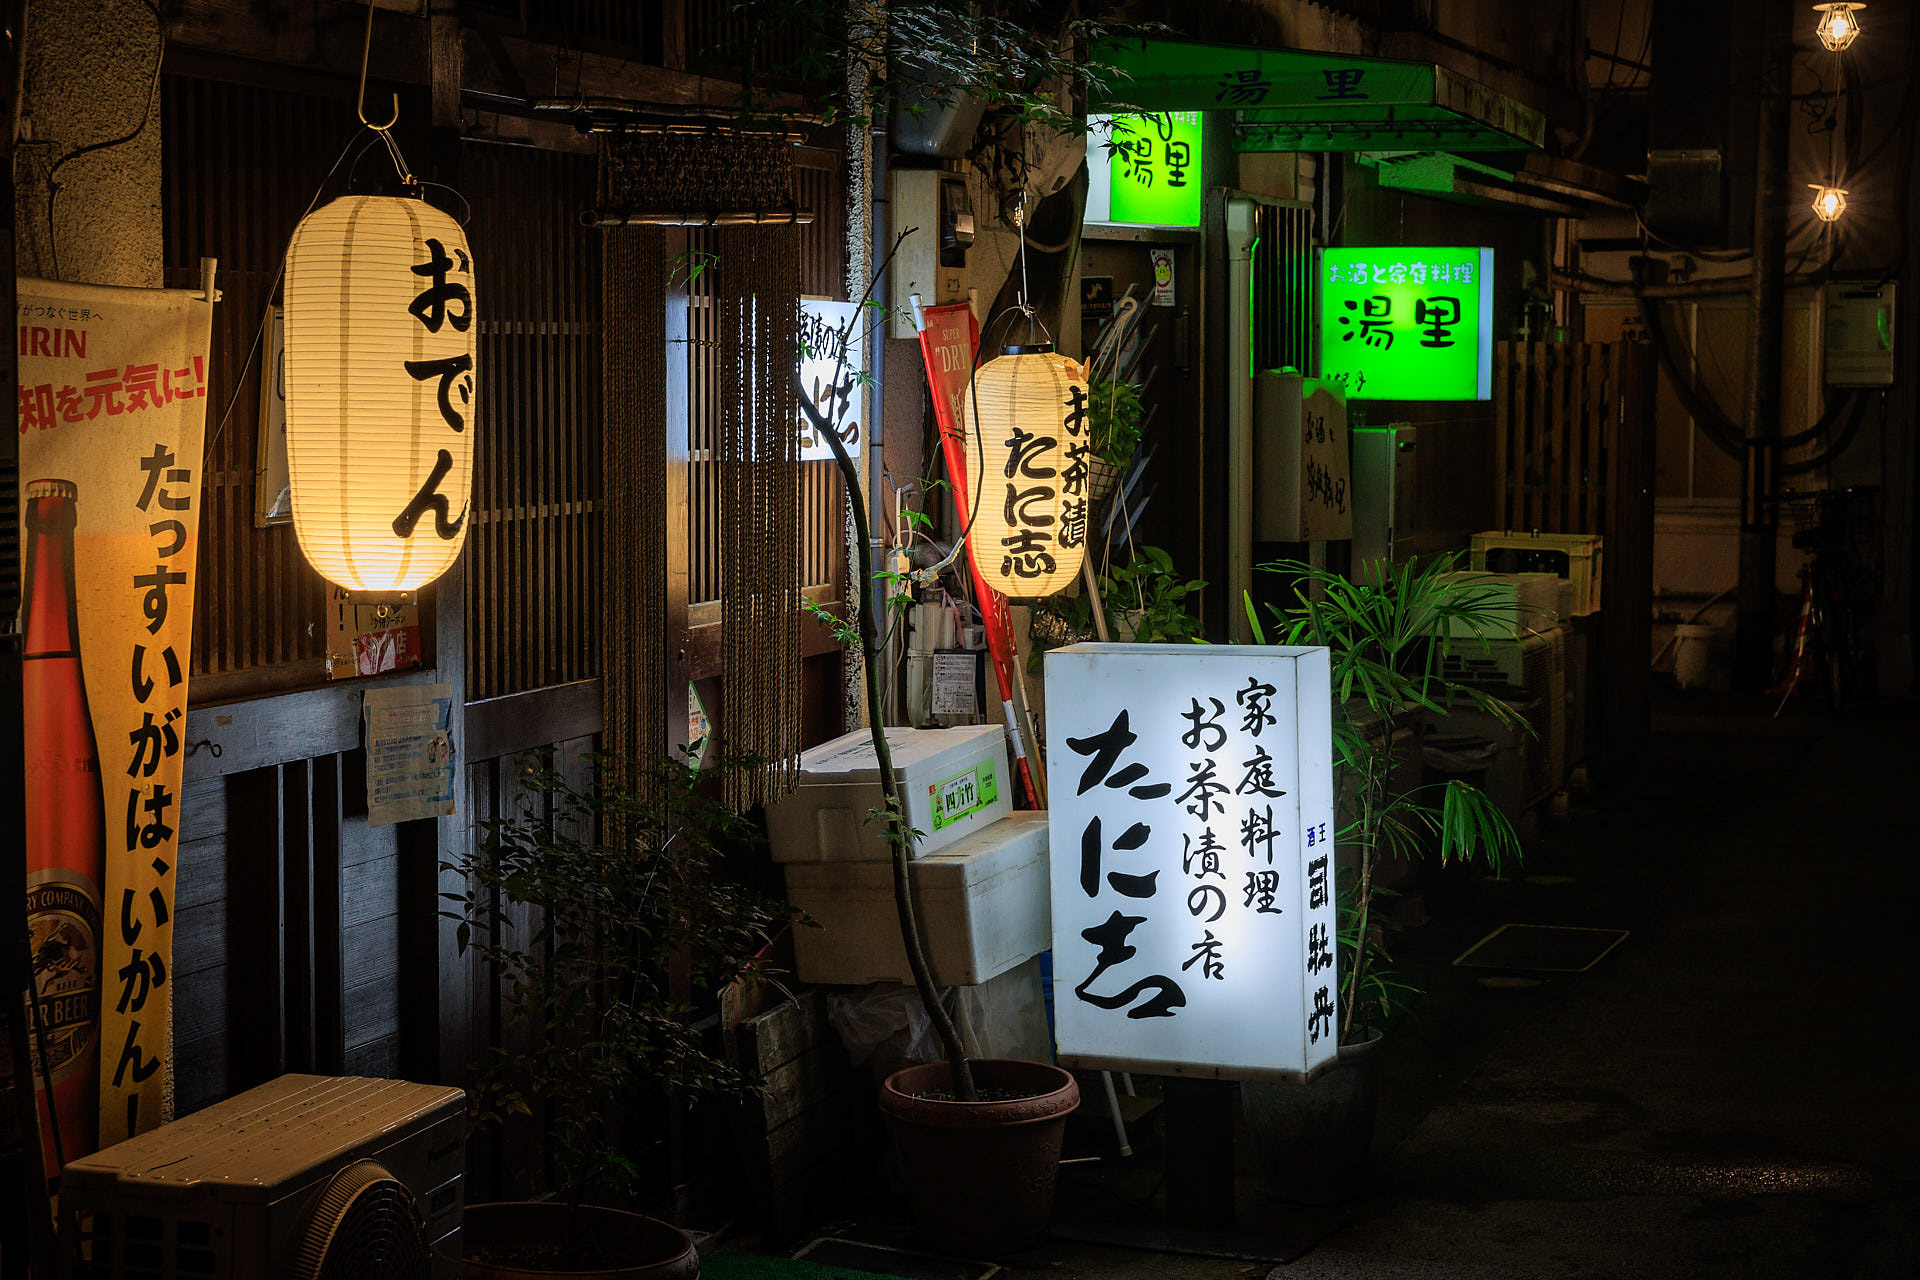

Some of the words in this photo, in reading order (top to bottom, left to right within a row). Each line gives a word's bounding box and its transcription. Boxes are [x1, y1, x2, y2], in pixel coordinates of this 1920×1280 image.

[1215, 69, 1369, 105] 湯里
[1328, 261, 1475, 285] お酒と家庭料理
[16, 303, 104, 322] がつなぐ世界へ
[1338, 295, 1462, 351] 湯里
[391, 237, 474, 541] おでん
[1000, 427, 1057, 578] たに志
[1235, 676, 1287, 915] 家庭料理
[1174, 697, 1231, 981] お茶漬の店
[54, 994, 89, 1025] BEER
